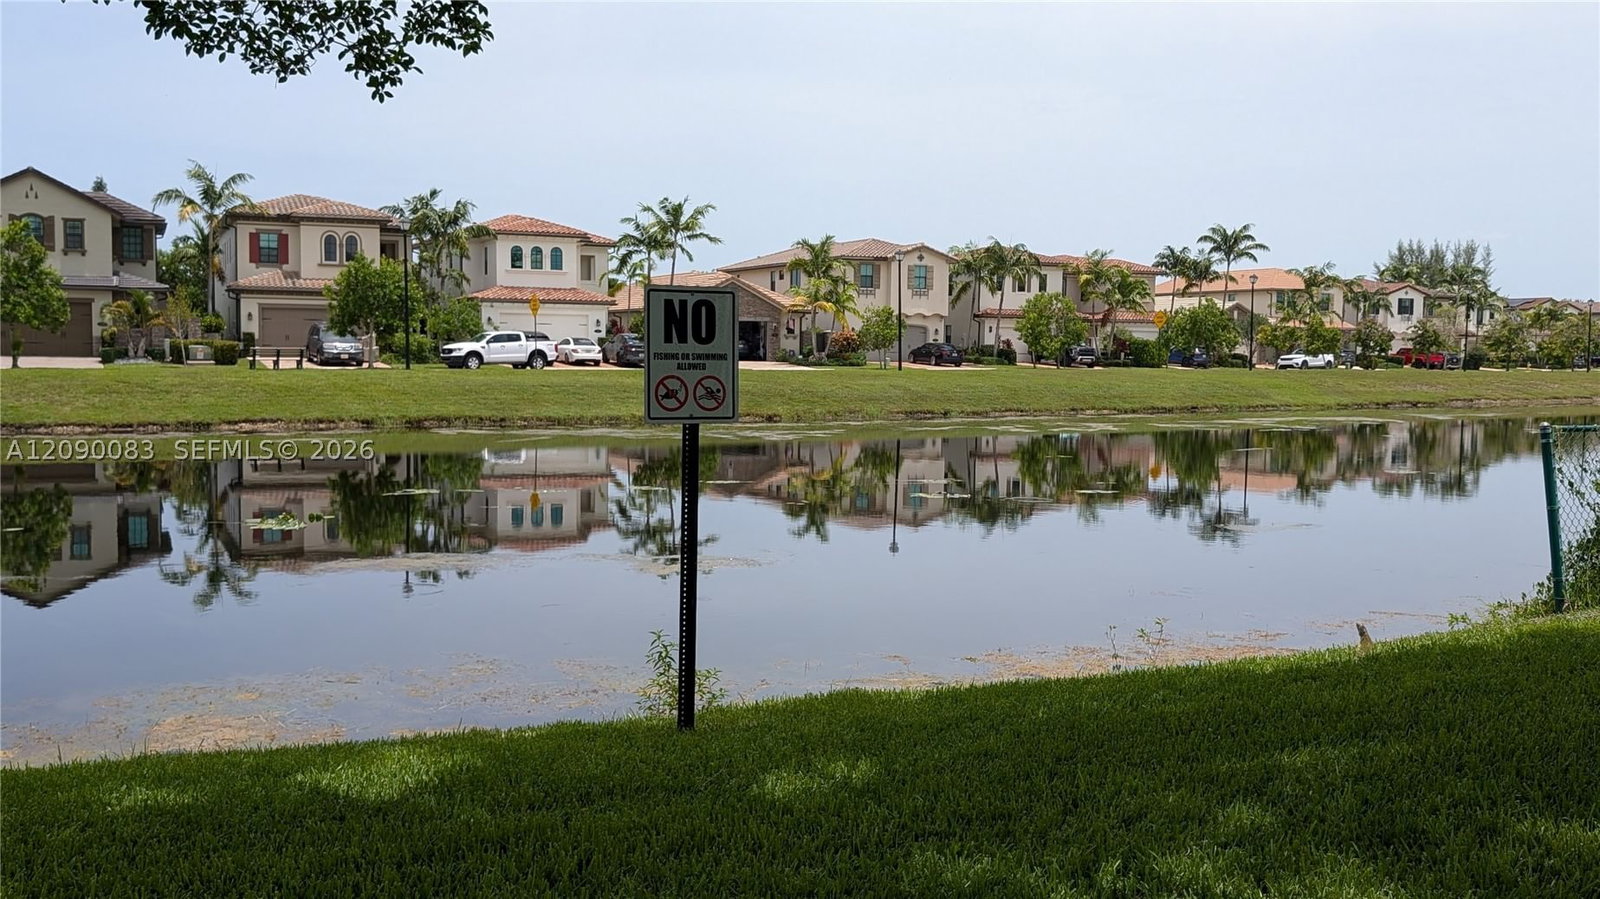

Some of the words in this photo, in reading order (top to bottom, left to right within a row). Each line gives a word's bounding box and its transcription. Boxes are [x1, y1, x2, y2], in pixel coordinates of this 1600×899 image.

[663, 298, 717, 346] NO
[653, 352, 680, 361] FISHING
[681, 353, 690, 361] OR
[691, 353, 728, 361] SWIMMING
[676, 362, 707, 371] ALLOWED
